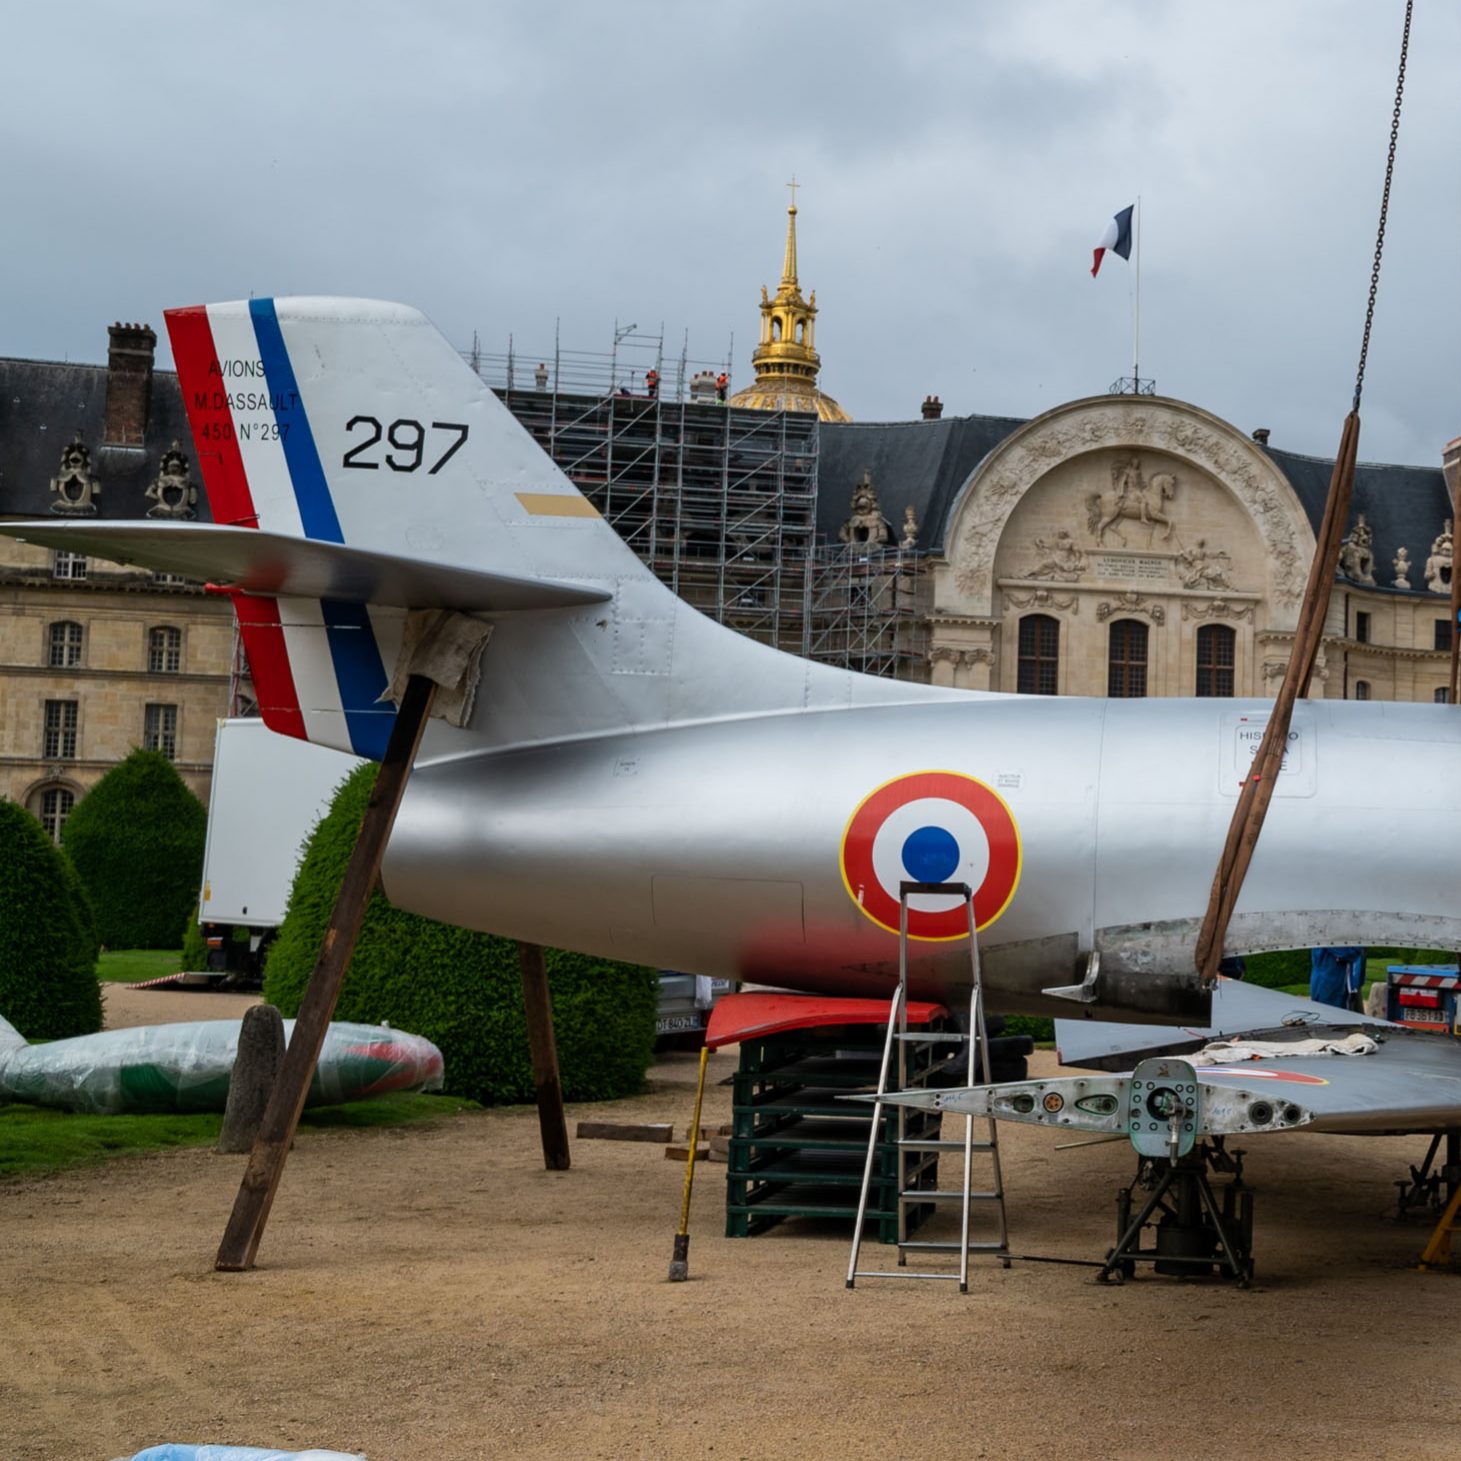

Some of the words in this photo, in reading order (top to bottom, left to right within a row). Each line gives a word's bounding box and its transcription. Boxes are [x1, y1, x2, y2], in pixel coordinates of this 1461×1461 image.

[208, 359, 266, 377] AVIONS
[194, 392, 298, 410] M.DASSAULT
[202, 422, 232, 440] 450
[343, 415, 469, 475] 297
[1240, 731, 1299, 741] HISO
